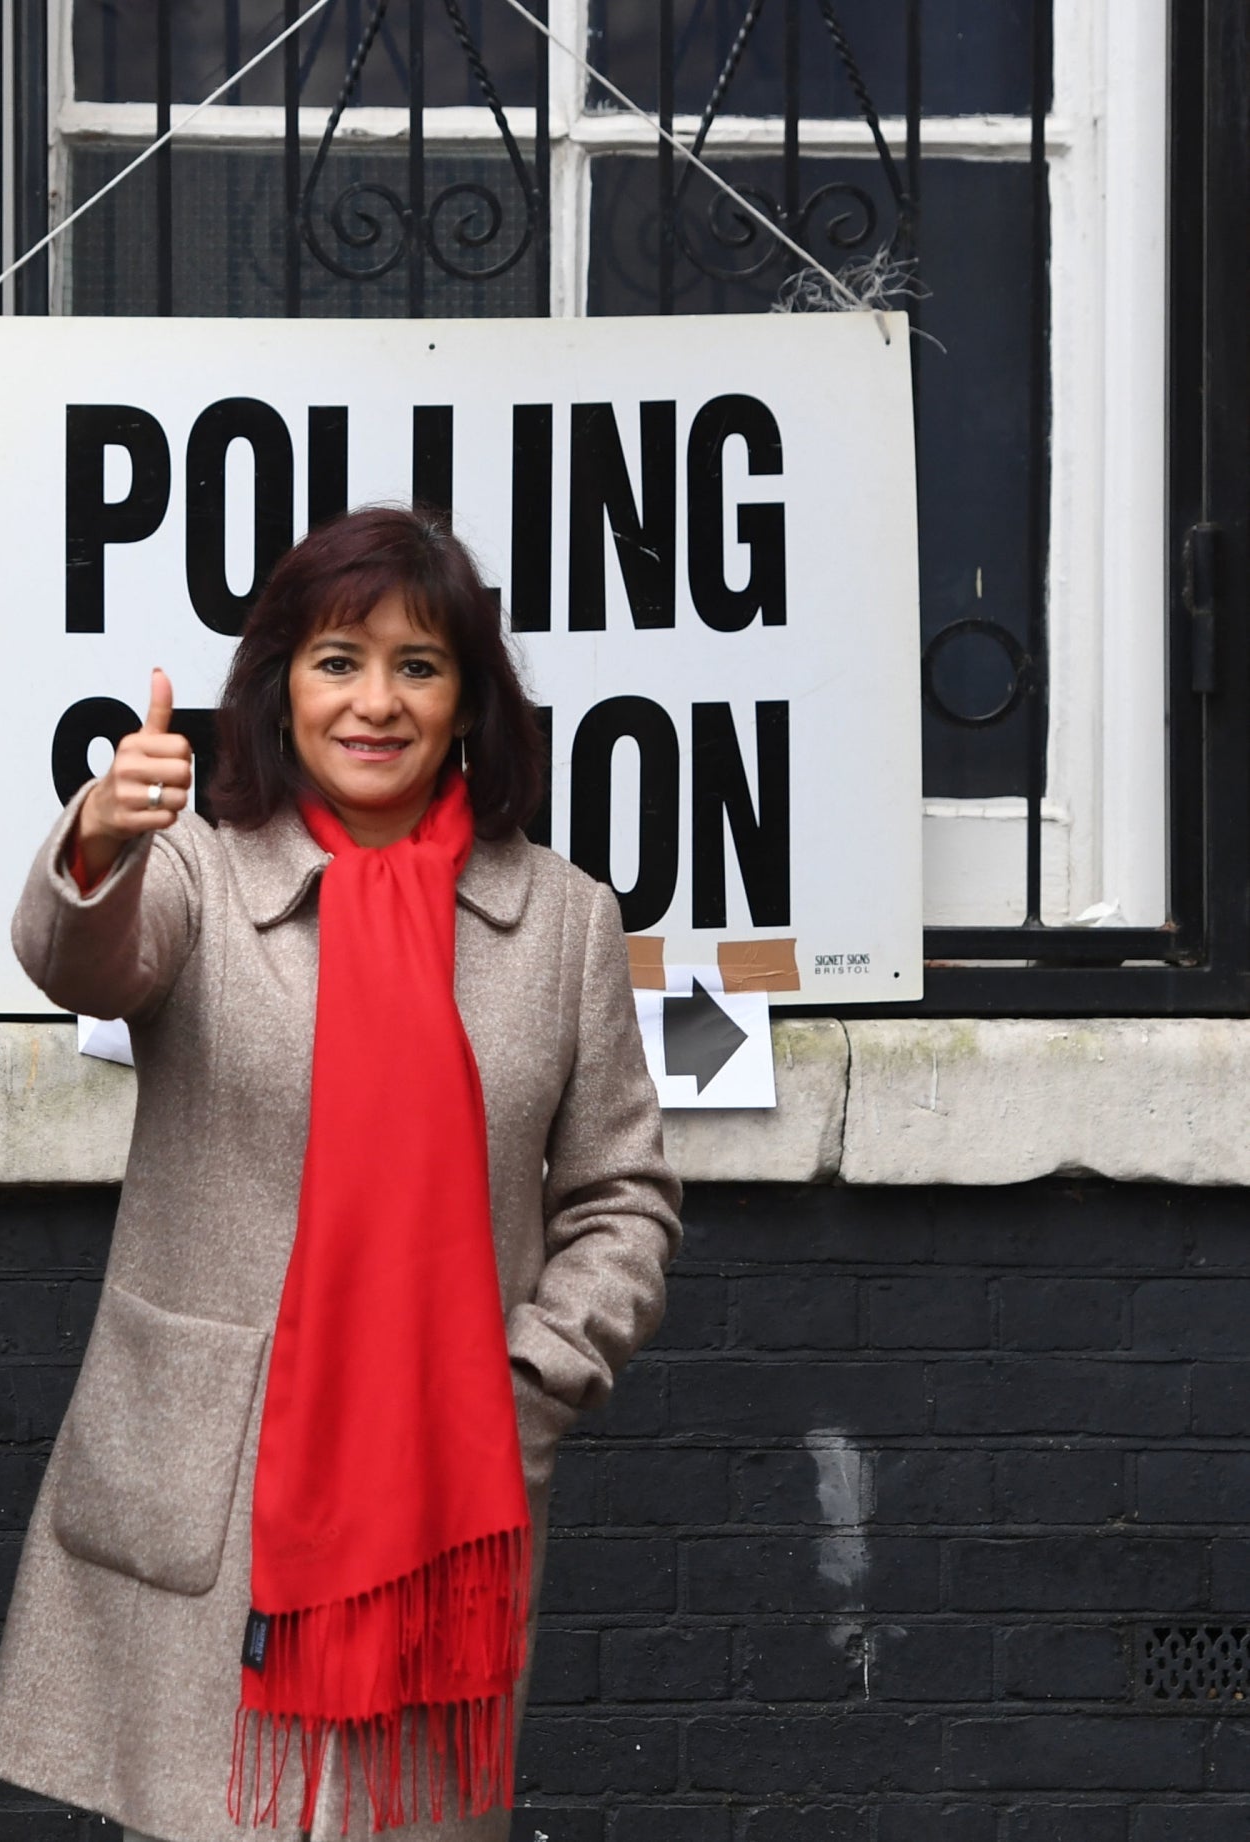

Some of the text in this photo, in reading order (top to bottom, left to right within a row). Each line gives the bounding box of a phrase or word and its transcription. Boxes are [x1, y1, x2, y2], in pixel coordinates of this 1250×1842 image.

[815, 954, 870, 966] SIGNET SIGNS
[815, 966, 869, 975] BRISTOL
